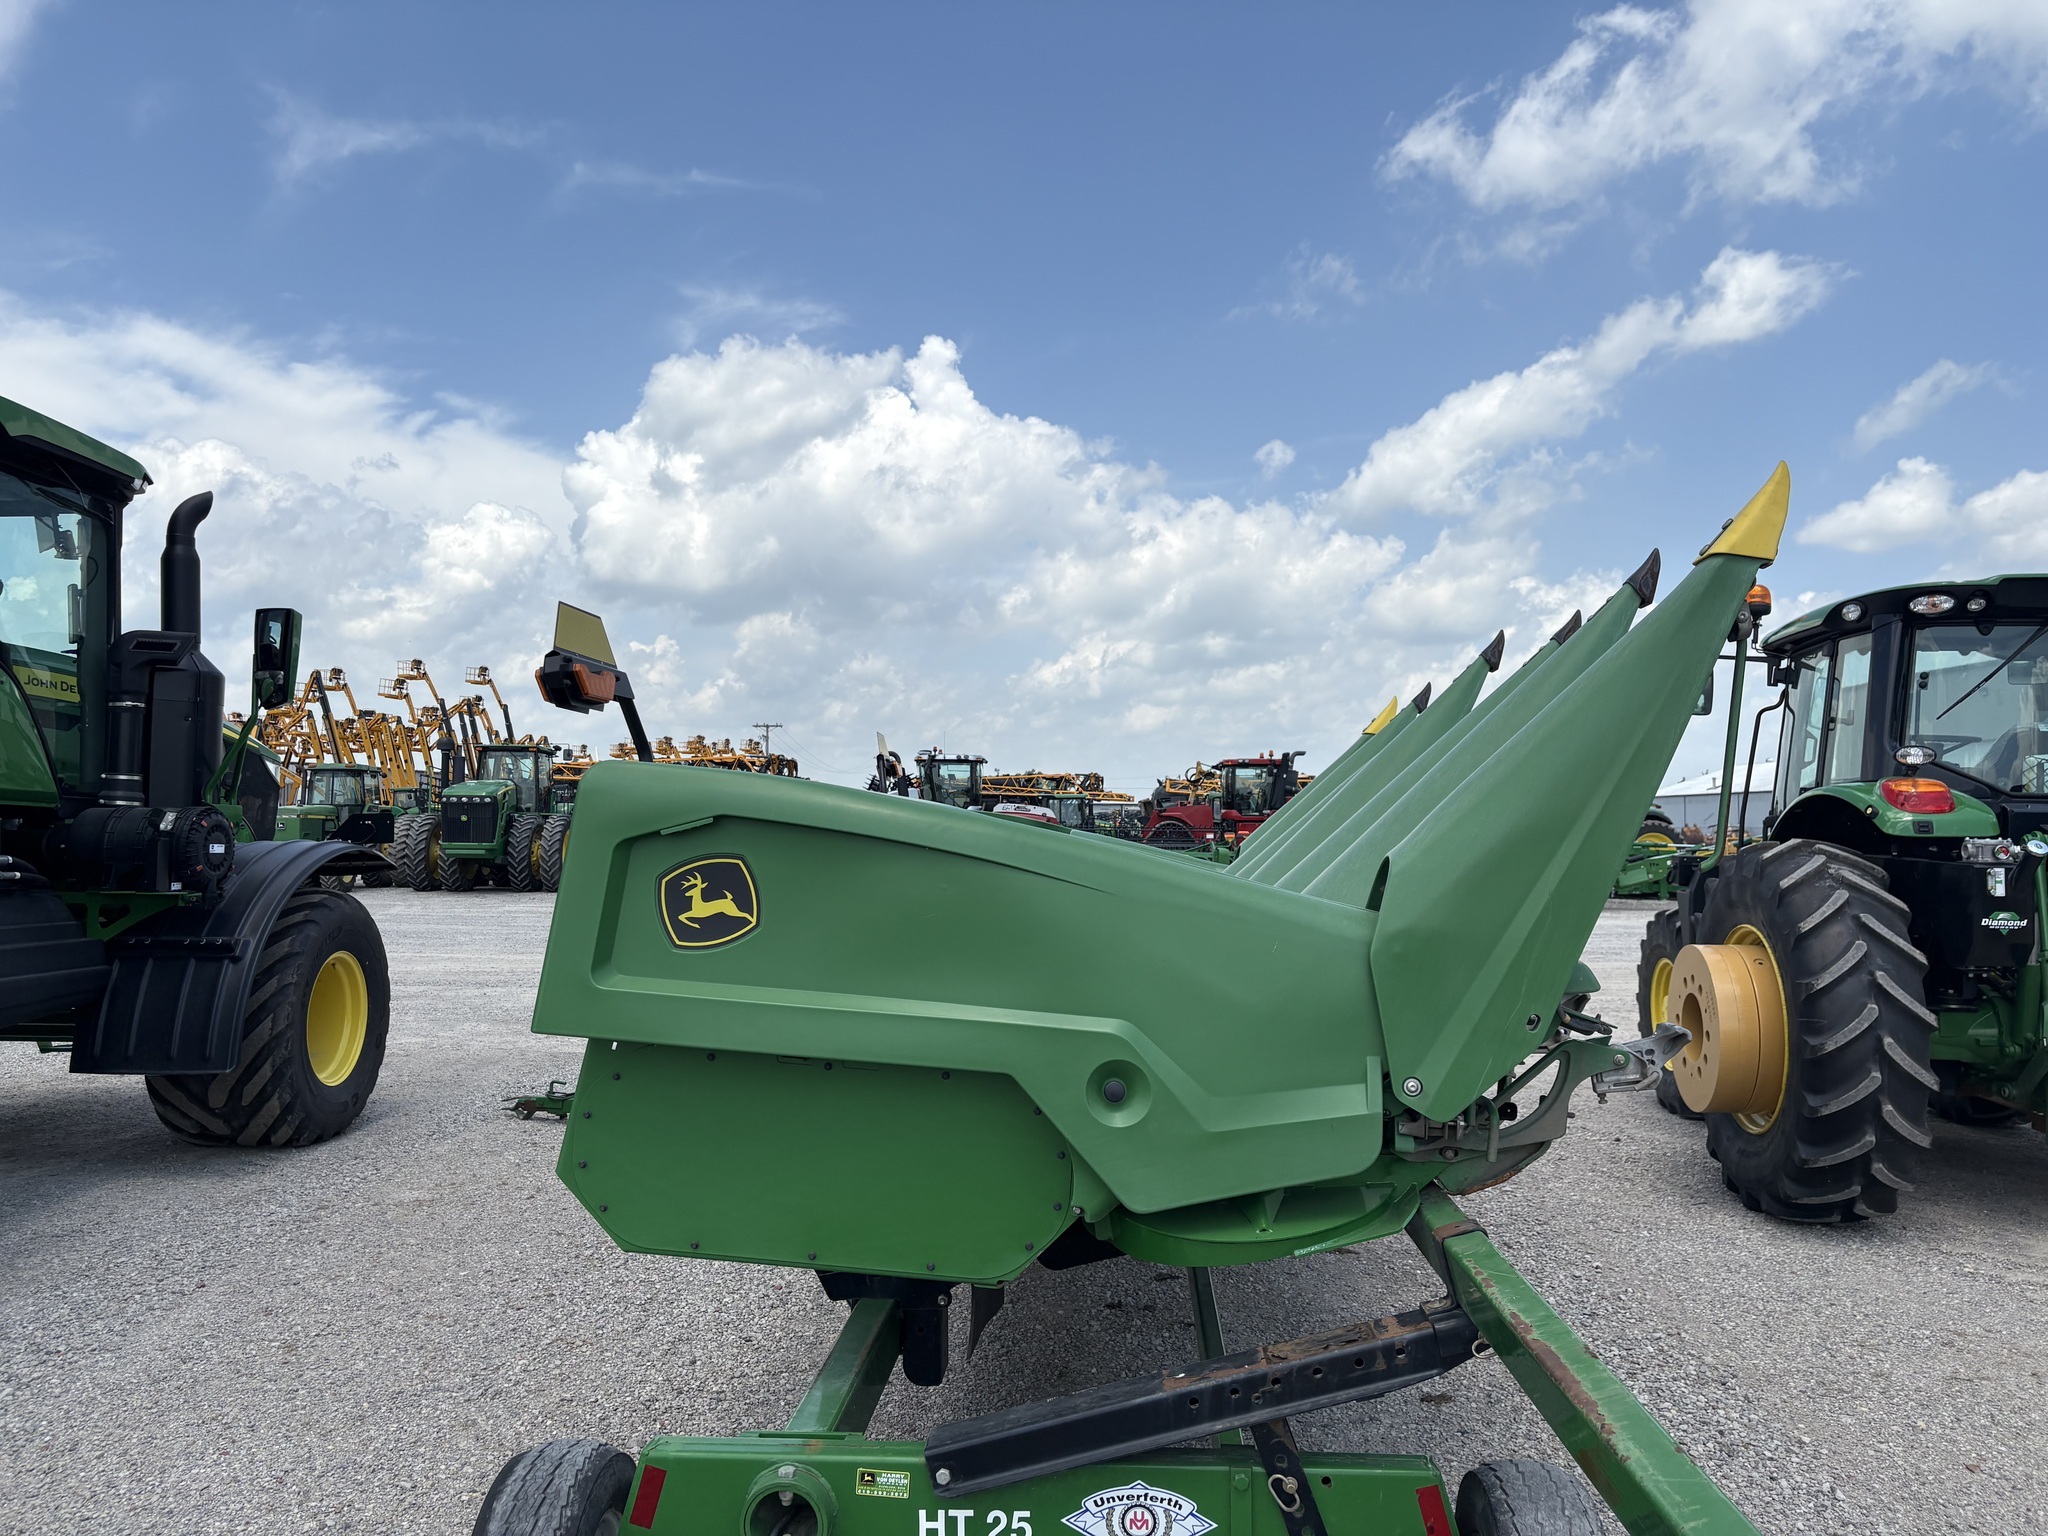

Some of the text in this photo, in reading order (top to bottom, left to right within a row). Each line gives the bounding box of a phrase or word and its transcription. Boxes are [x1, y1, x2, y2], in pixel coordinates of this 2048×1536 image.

[24, 675, 77, 694] JOHN DE
[1981, 918, 2028, 927] Diamond
[1093, 1492, 1183, 1511] Unverferth
[918, 1509, 1033, 1536] HT 25
